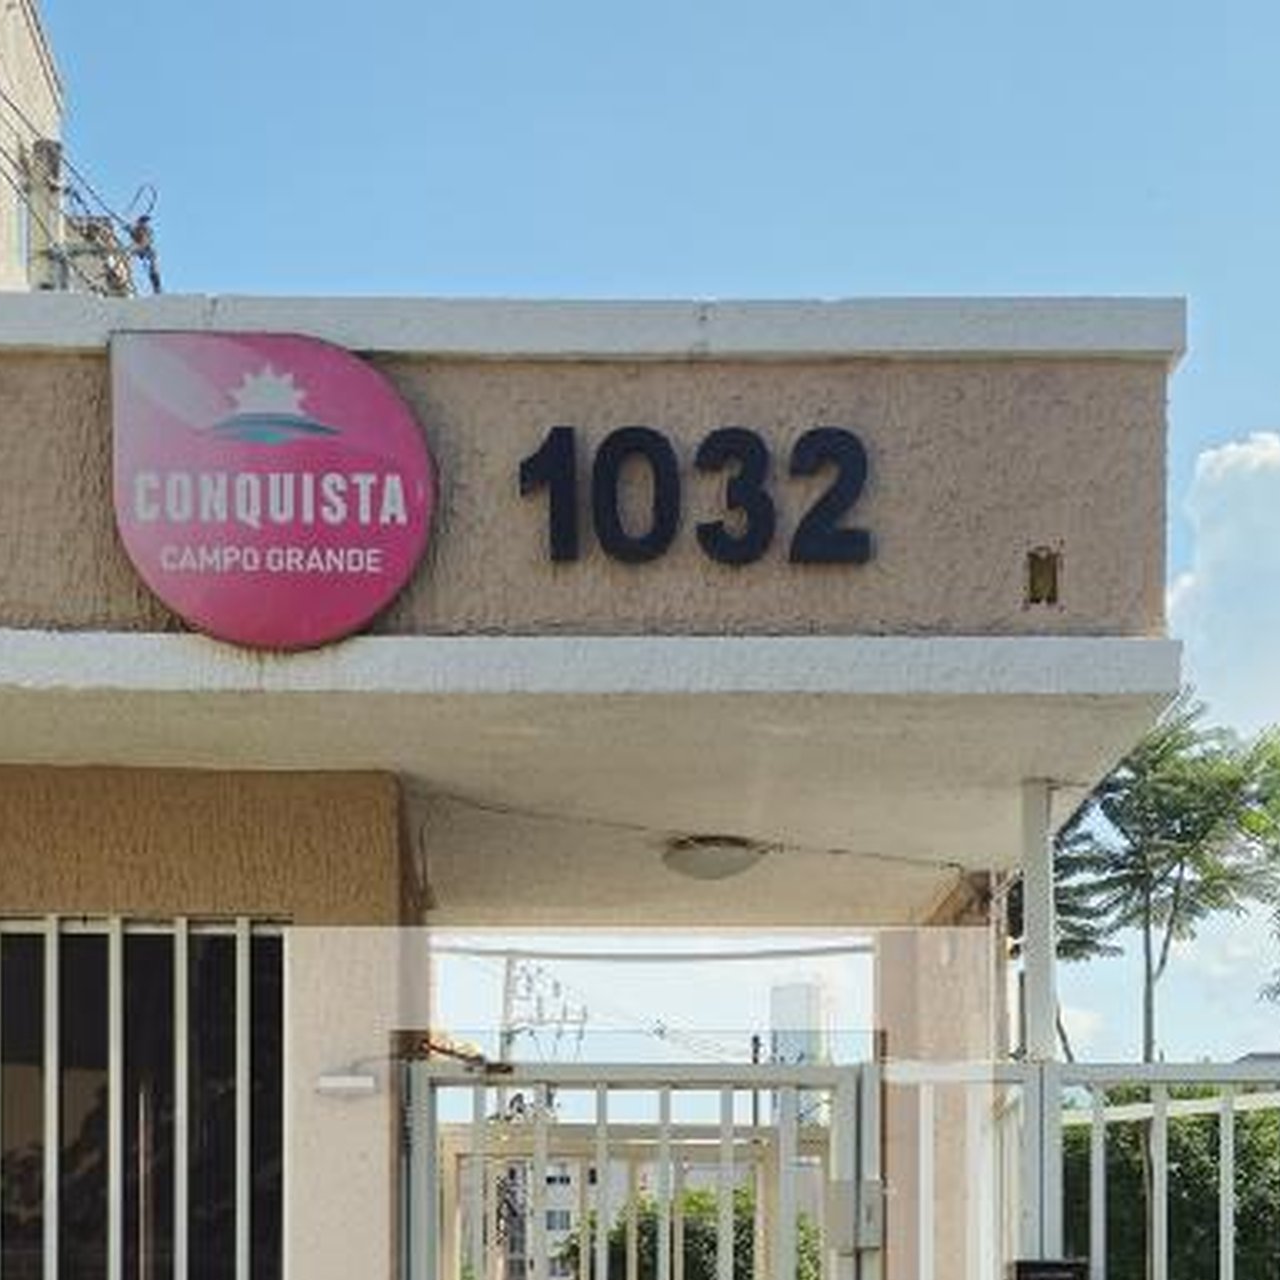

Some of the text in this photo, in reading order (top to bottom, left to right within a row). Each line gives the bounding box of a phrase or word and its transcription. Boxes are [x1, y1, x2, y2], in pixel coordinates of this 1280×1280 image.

[132, 472, 408, 528] CONQUISTA
[519, 426, 873, 566] 1032
[161, 547, 382, 572] CAMPO GRANDE
